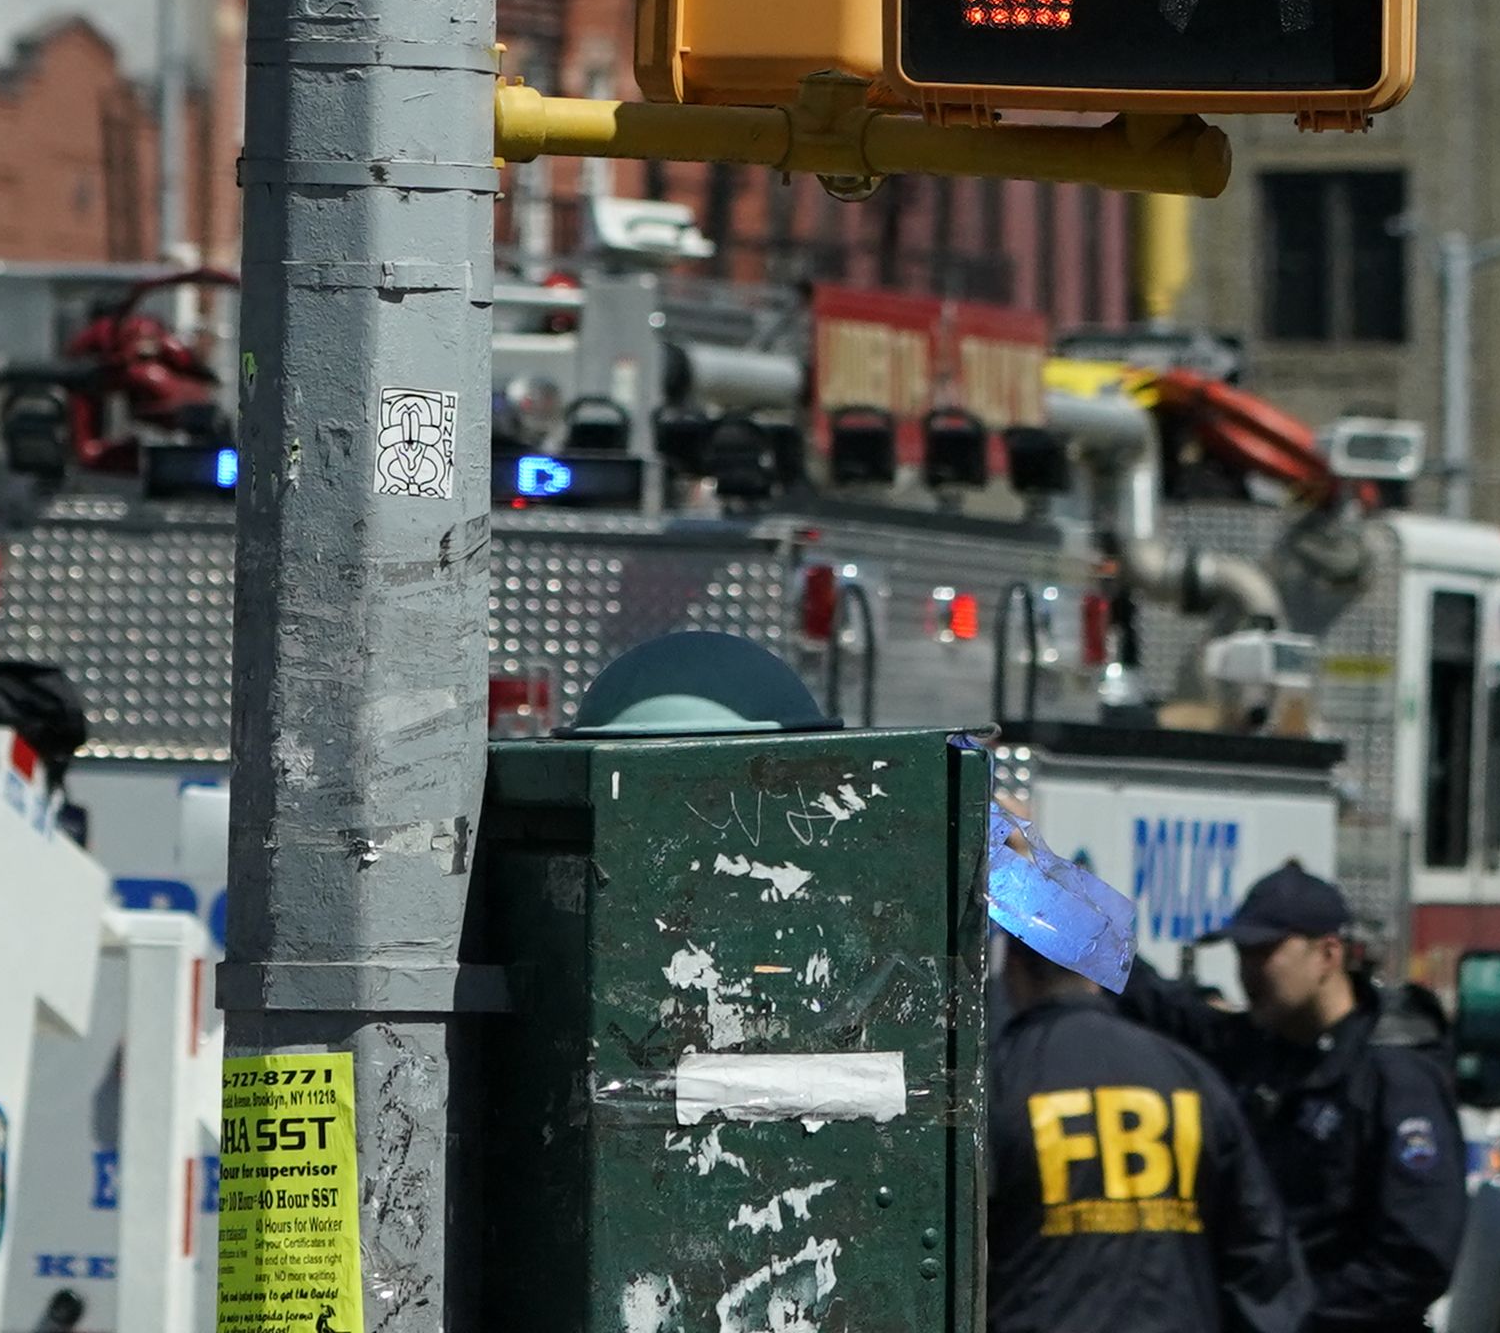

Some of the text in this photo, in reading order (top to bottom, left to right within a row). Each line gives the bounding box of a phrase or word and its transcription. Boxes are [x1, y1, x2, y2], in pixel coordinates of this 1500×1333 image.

[1132, 817, 1240, 943] POLICE
[290, 1091, 304, 1105] NY
[307, 1089, 337, 1105] 11218
[220, 1116, 337, 1154] HA SST
[1028, 1085, 1203, 1205] FBI
[256, 1160, 338, 1181] supervisor
[276, 1189, 309, 1209] Hour
[311, 1188, 339, 1208] SST
[264, 1218, 292, 1234] Hours
[294, 1217, 307, 1233] for
[308, 1216, 343, 1232] Worker
[283, 1237, 326, 1250] Certificates
[265, 1255, 279, 1266] end
[280, 1253, 289, 1265] of
[289, 1253, 301, 1264] the
[303, 1252, 323, 1264] class
[324, 1253, 342, 1267] right
[274, 1270, 287, 1282] NO
[288, 1270, 307, 1282] more
[308, 1269, 338, 1284] waiting.
[269, 1289, 279, 1300] to
[280, 1288, 294, 1303] get
[296, 1288, 309, 1300] the
[285, 1310, 314, 1323] forma
